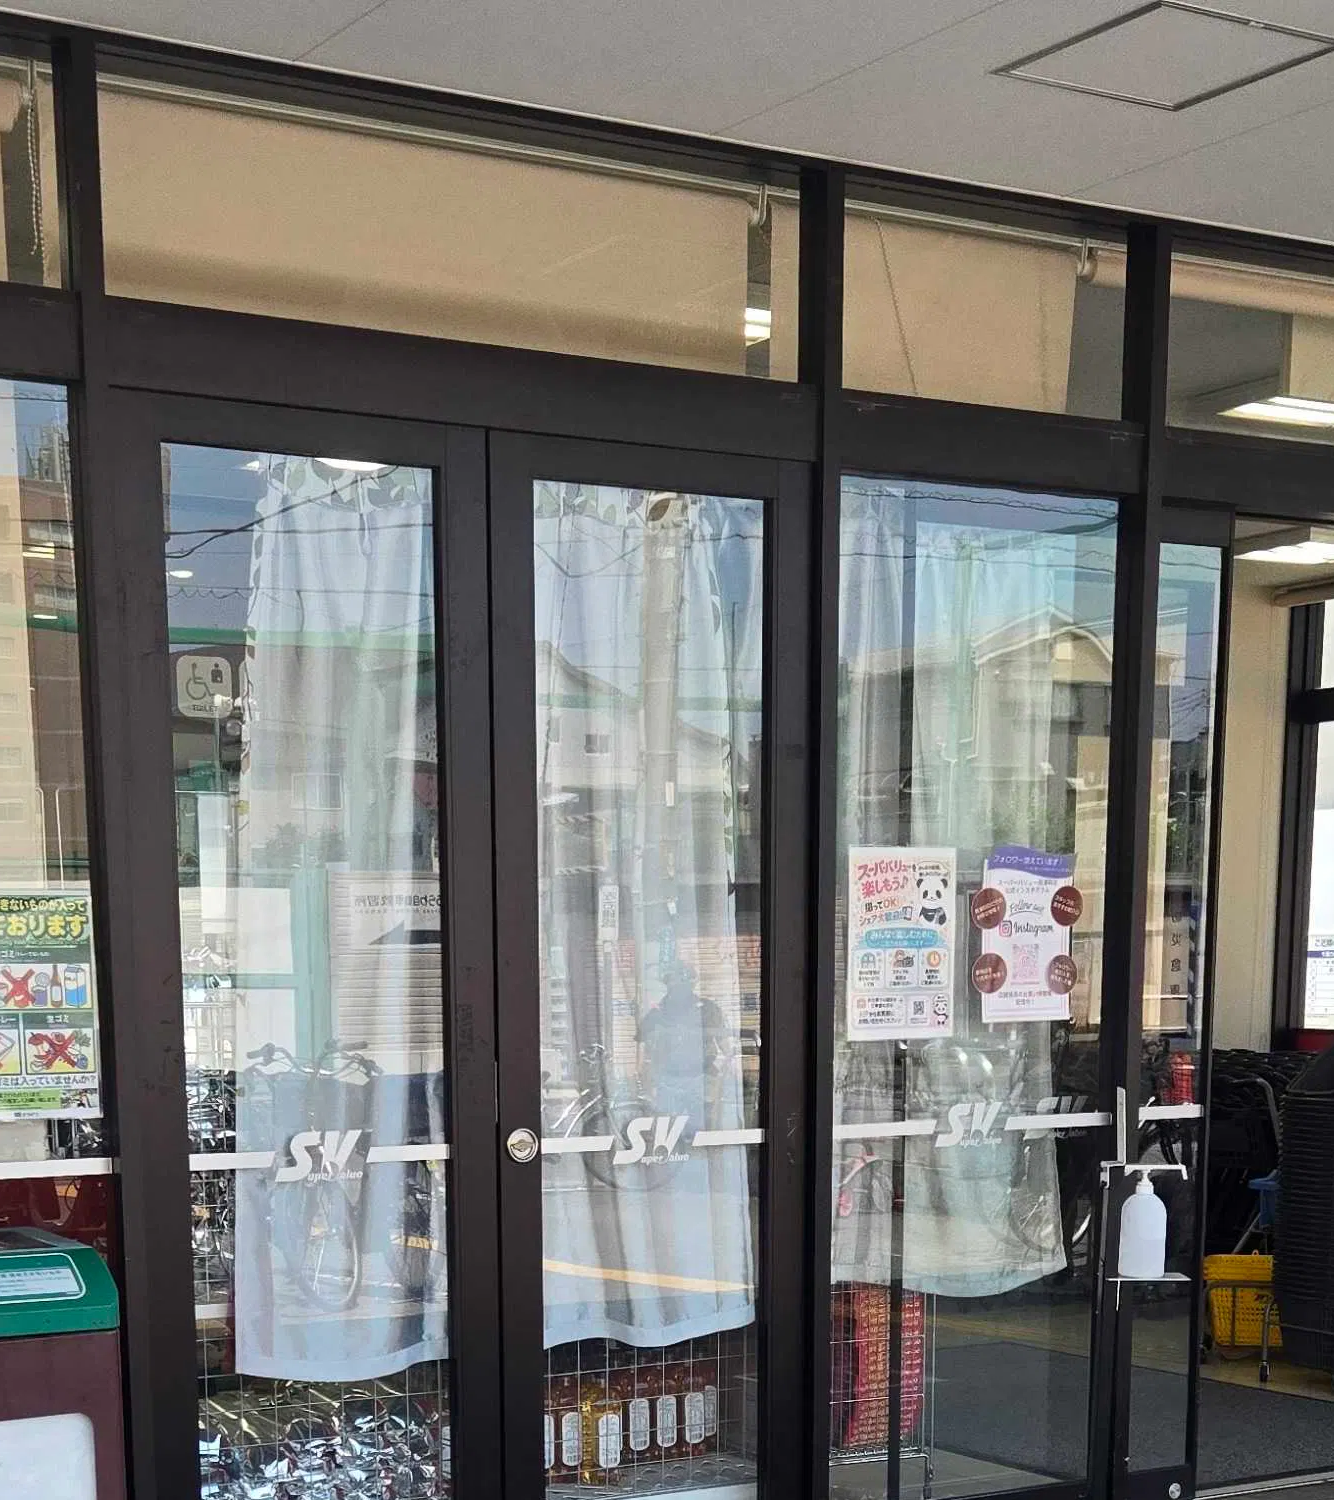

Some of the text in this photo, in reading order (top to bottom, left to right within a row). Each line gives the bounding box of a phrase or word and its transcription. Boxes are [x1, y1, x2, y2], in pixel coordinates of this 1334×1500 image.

[1013, 922, 1054, 937] Instagram
[613, 1115, 689, 1165] SV
[935, 1102, 1002, 1148] SV
[275, 1129, 364, 1182] SV
